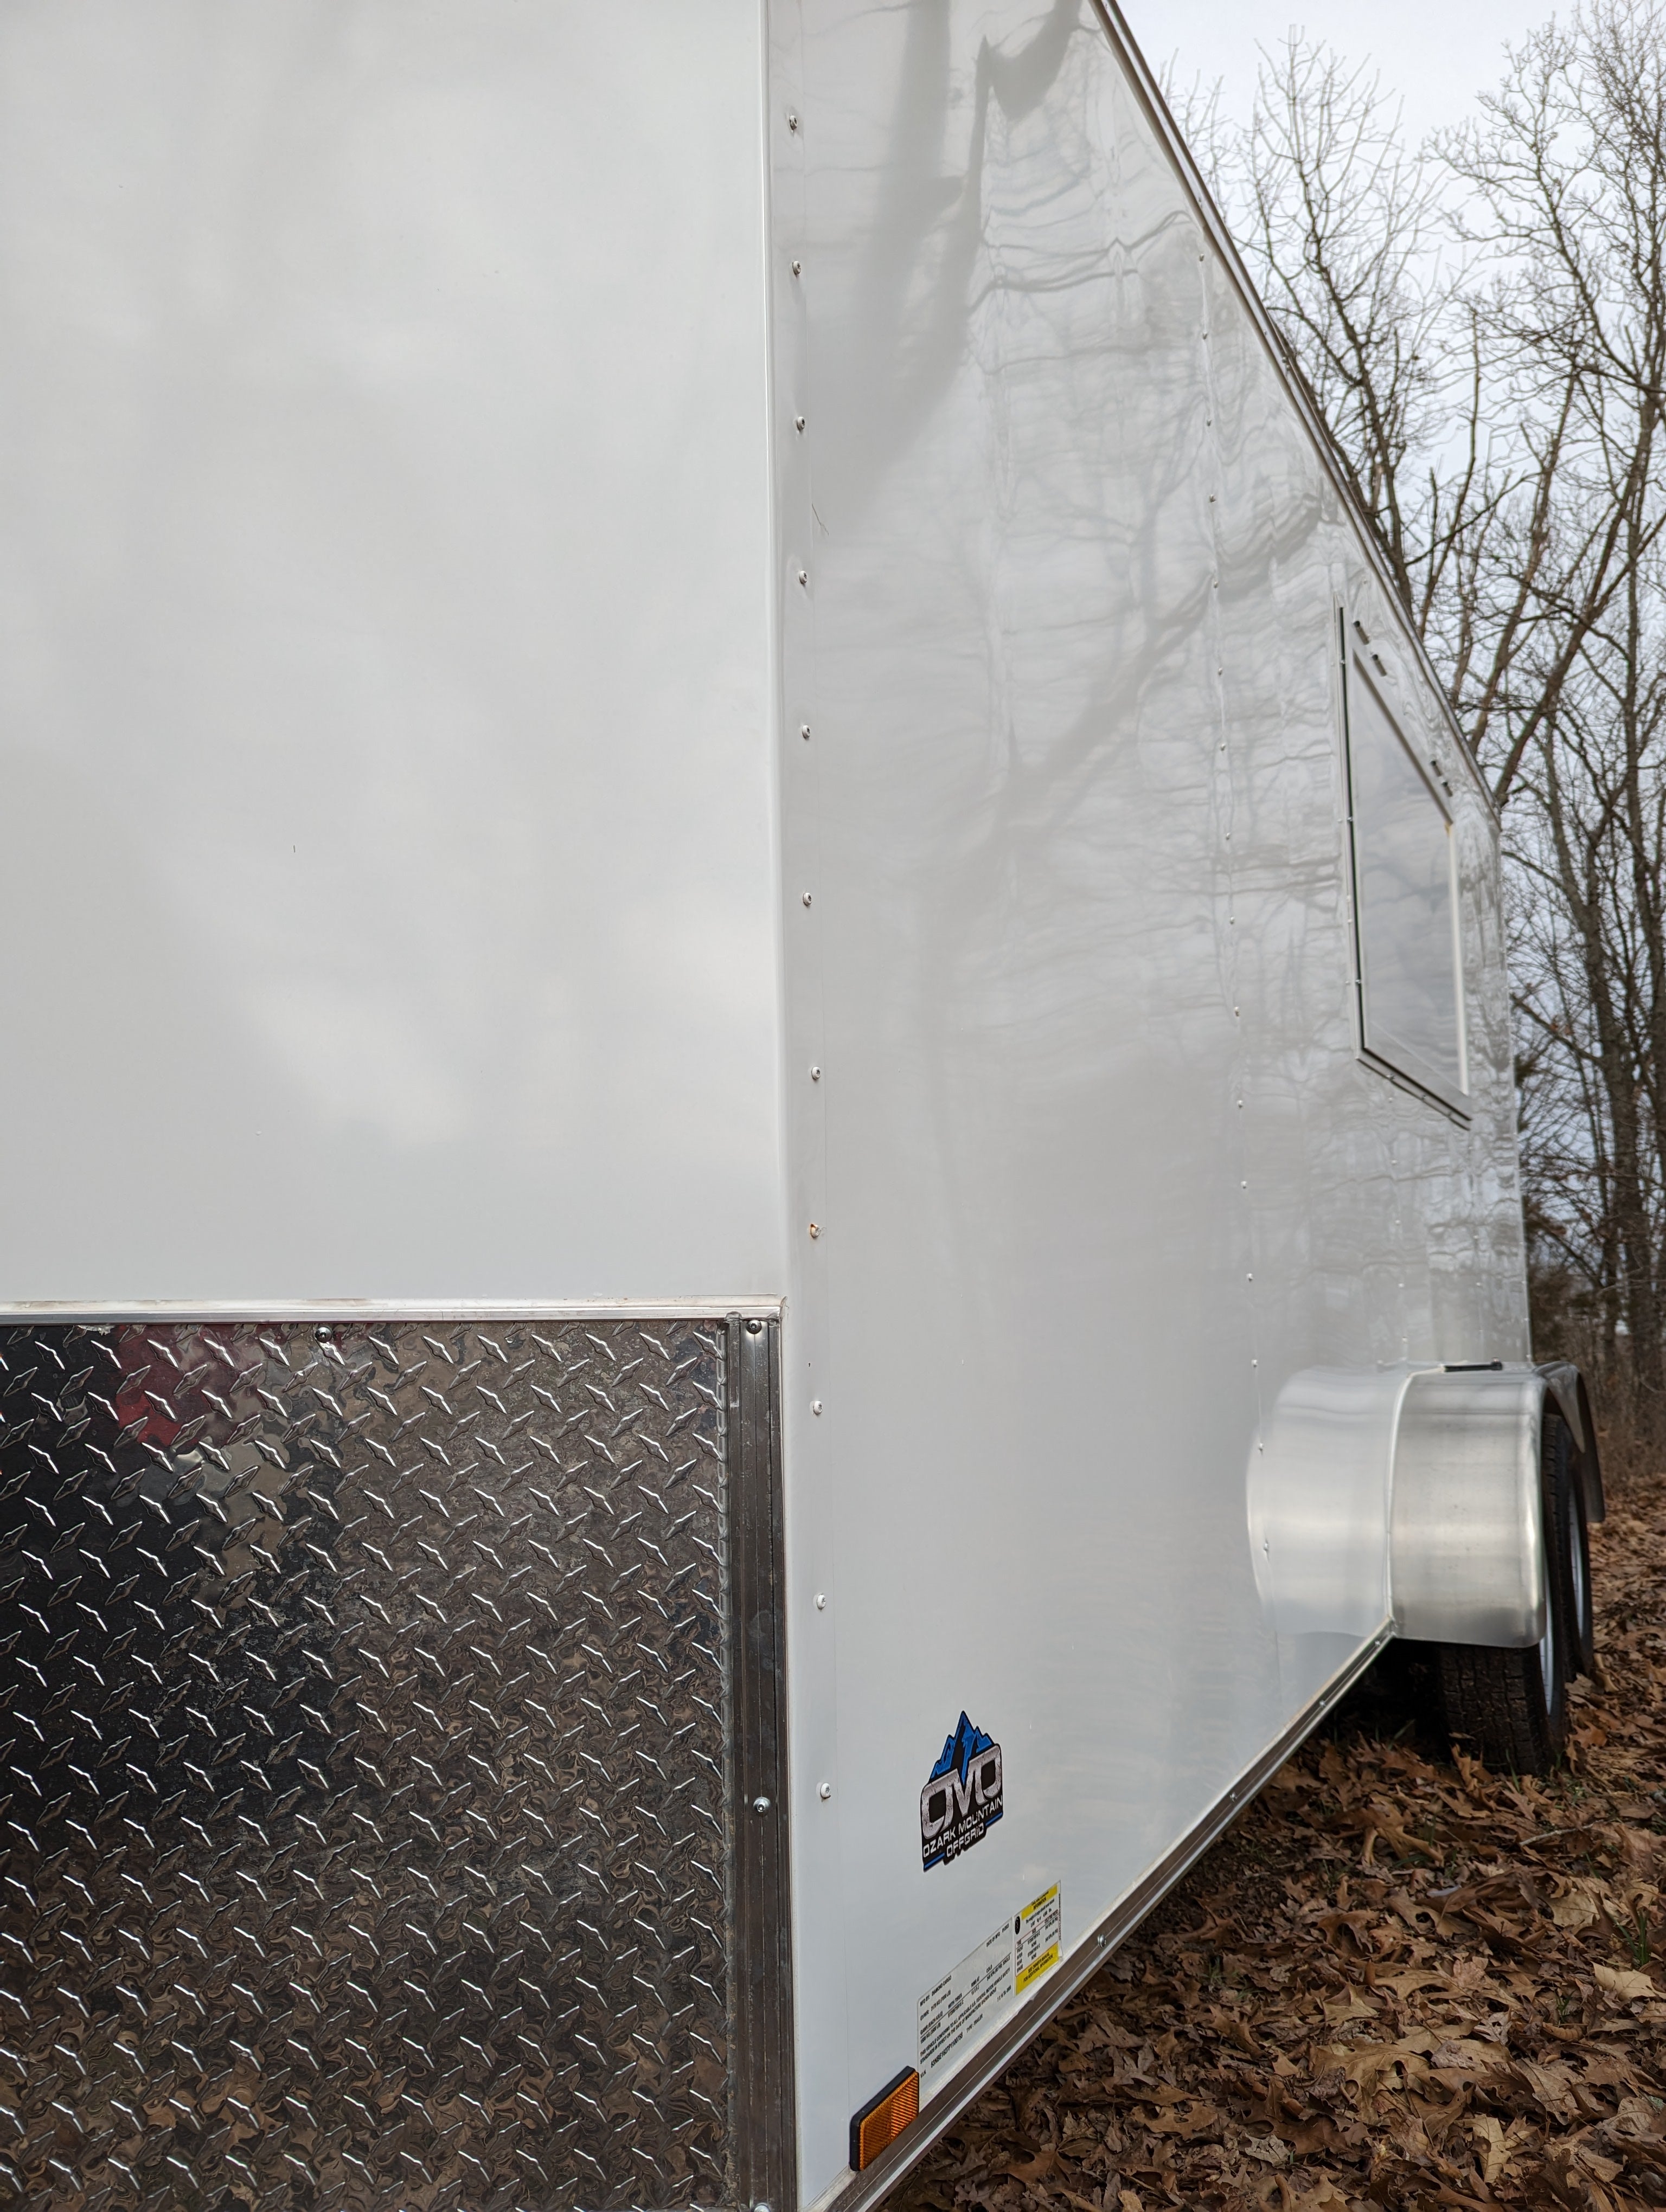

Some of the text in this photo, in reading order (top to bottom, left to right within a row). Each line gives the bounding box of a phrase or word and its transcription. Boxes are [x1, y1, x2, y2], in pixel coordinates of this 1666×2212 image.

[923, 1795, 1003, 1858] OZARK MOUNTAIN
[946, 1822, 984, 1857] OFFGRID
[931, 1983, 943, 1997] DIAMOND
[943, 1975, 952, 1986] CARGO
[926, 2038, 937, 2052] VEHICLE
[936, 2025, 950, 2042] CONFORMS
[920, 2047, 935, 2065] STANDARDS
